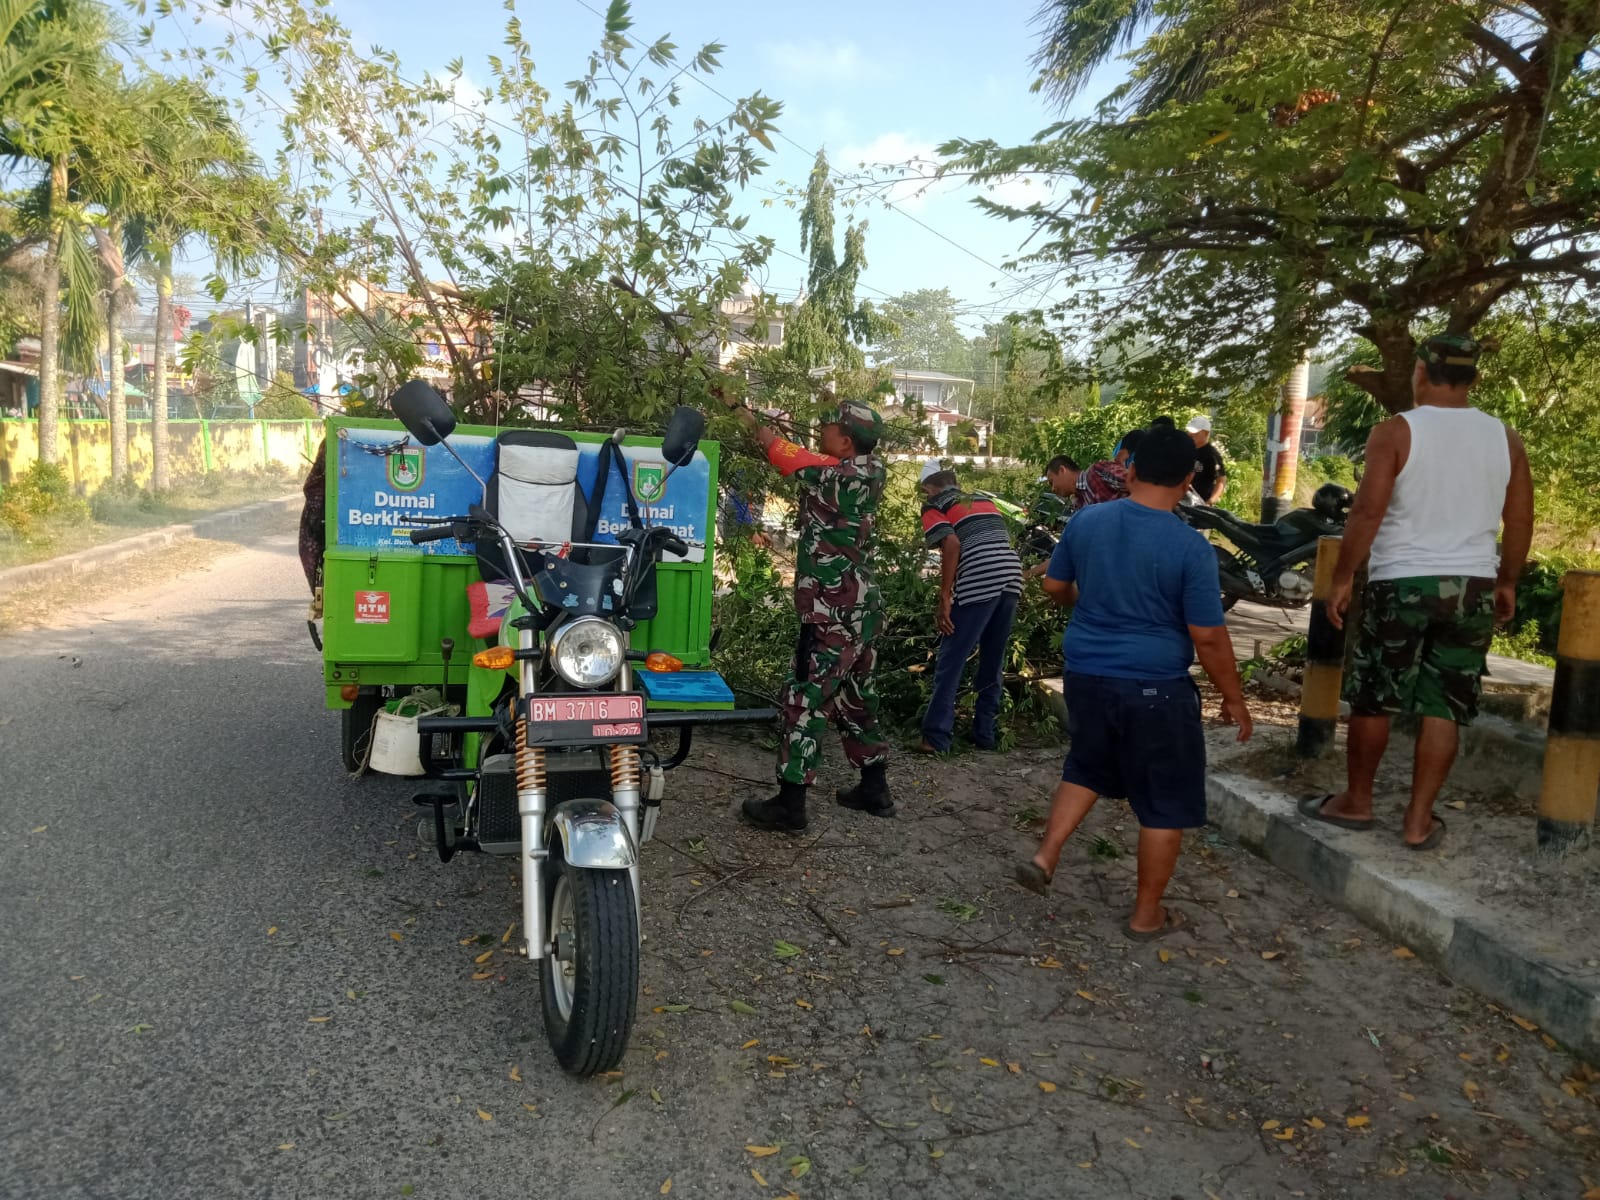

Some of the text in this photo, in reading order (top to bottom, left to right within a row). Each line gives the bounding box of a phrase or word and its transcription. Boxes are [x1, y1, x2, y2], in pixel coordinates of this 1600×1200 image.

[374, 491, 435, 509] Dumai
[597, 519, 695, 538] Bermat
[358, 603, 387, 613] HTM
[533, 700, 640, 721] BM 3716 R
